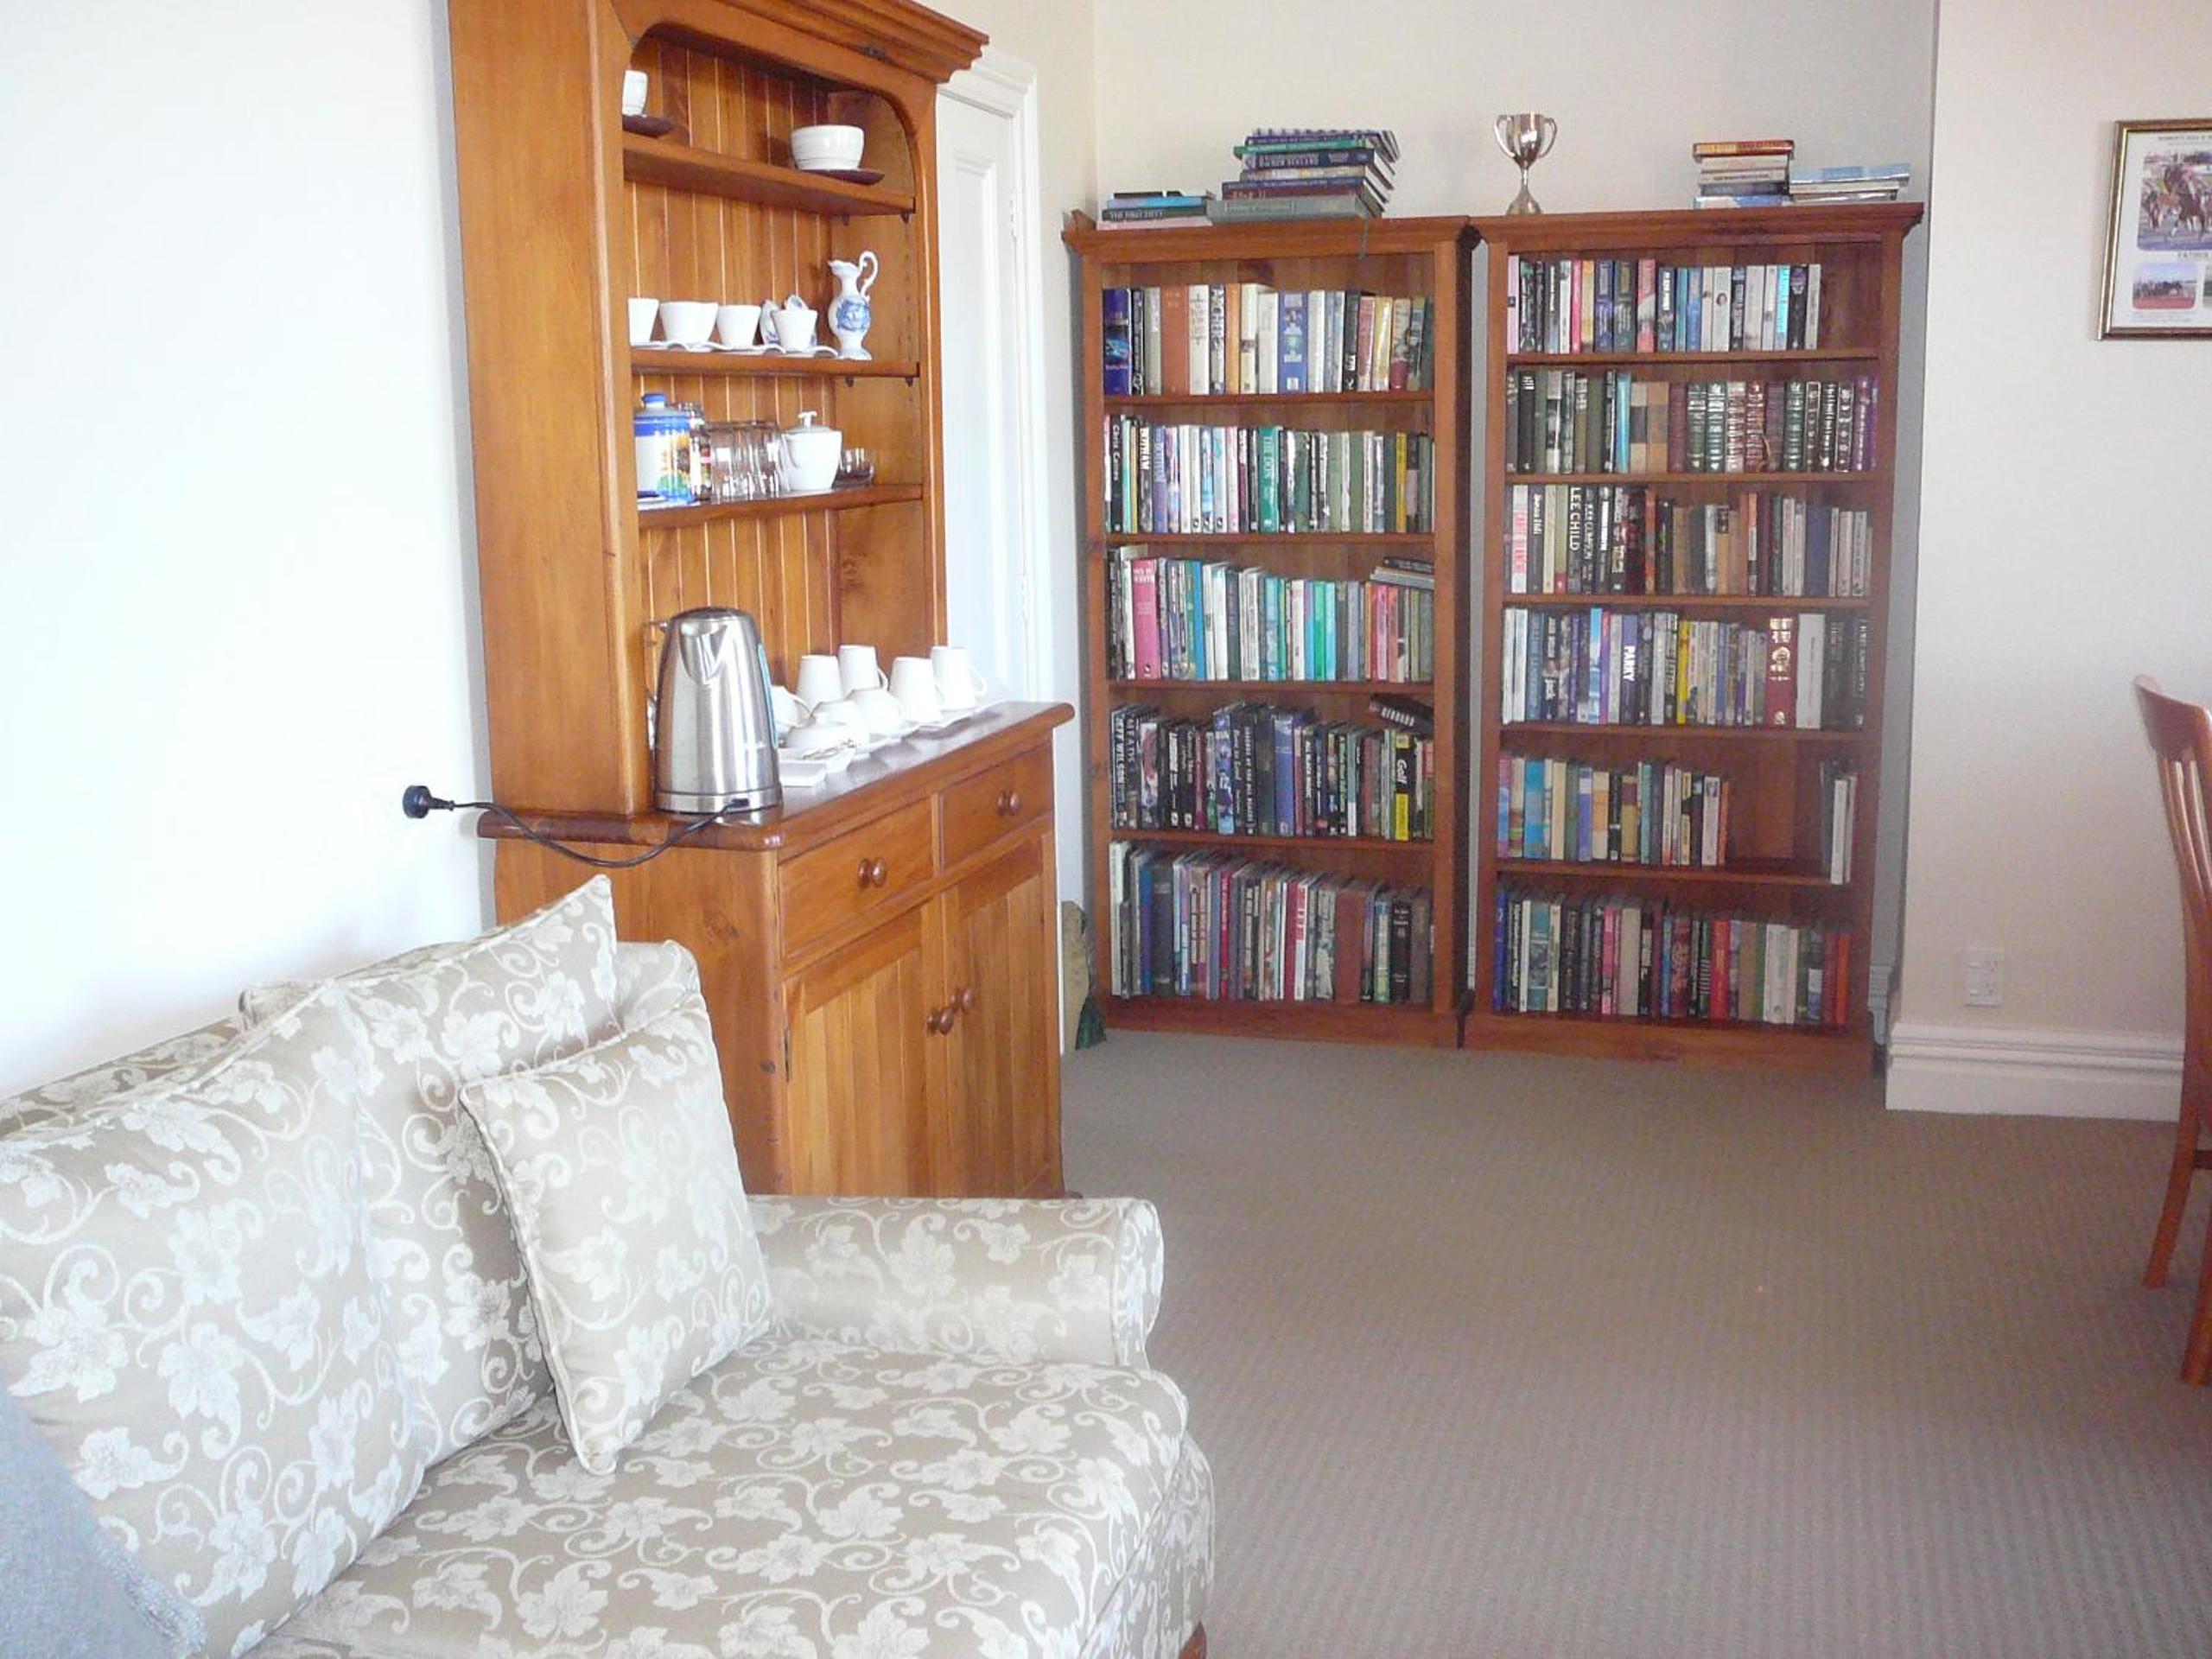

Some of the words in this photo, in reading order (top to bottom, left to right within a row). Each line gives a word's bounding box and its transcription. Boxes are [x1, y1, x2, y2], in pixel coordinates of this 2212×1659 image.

[1569, 486, 1582, 511] LEE
[1569, 512, 1582, 551] CHILD
[1623, 645, 1637, 682] PARKY
[1396, 759, 1408, 785] Golf
